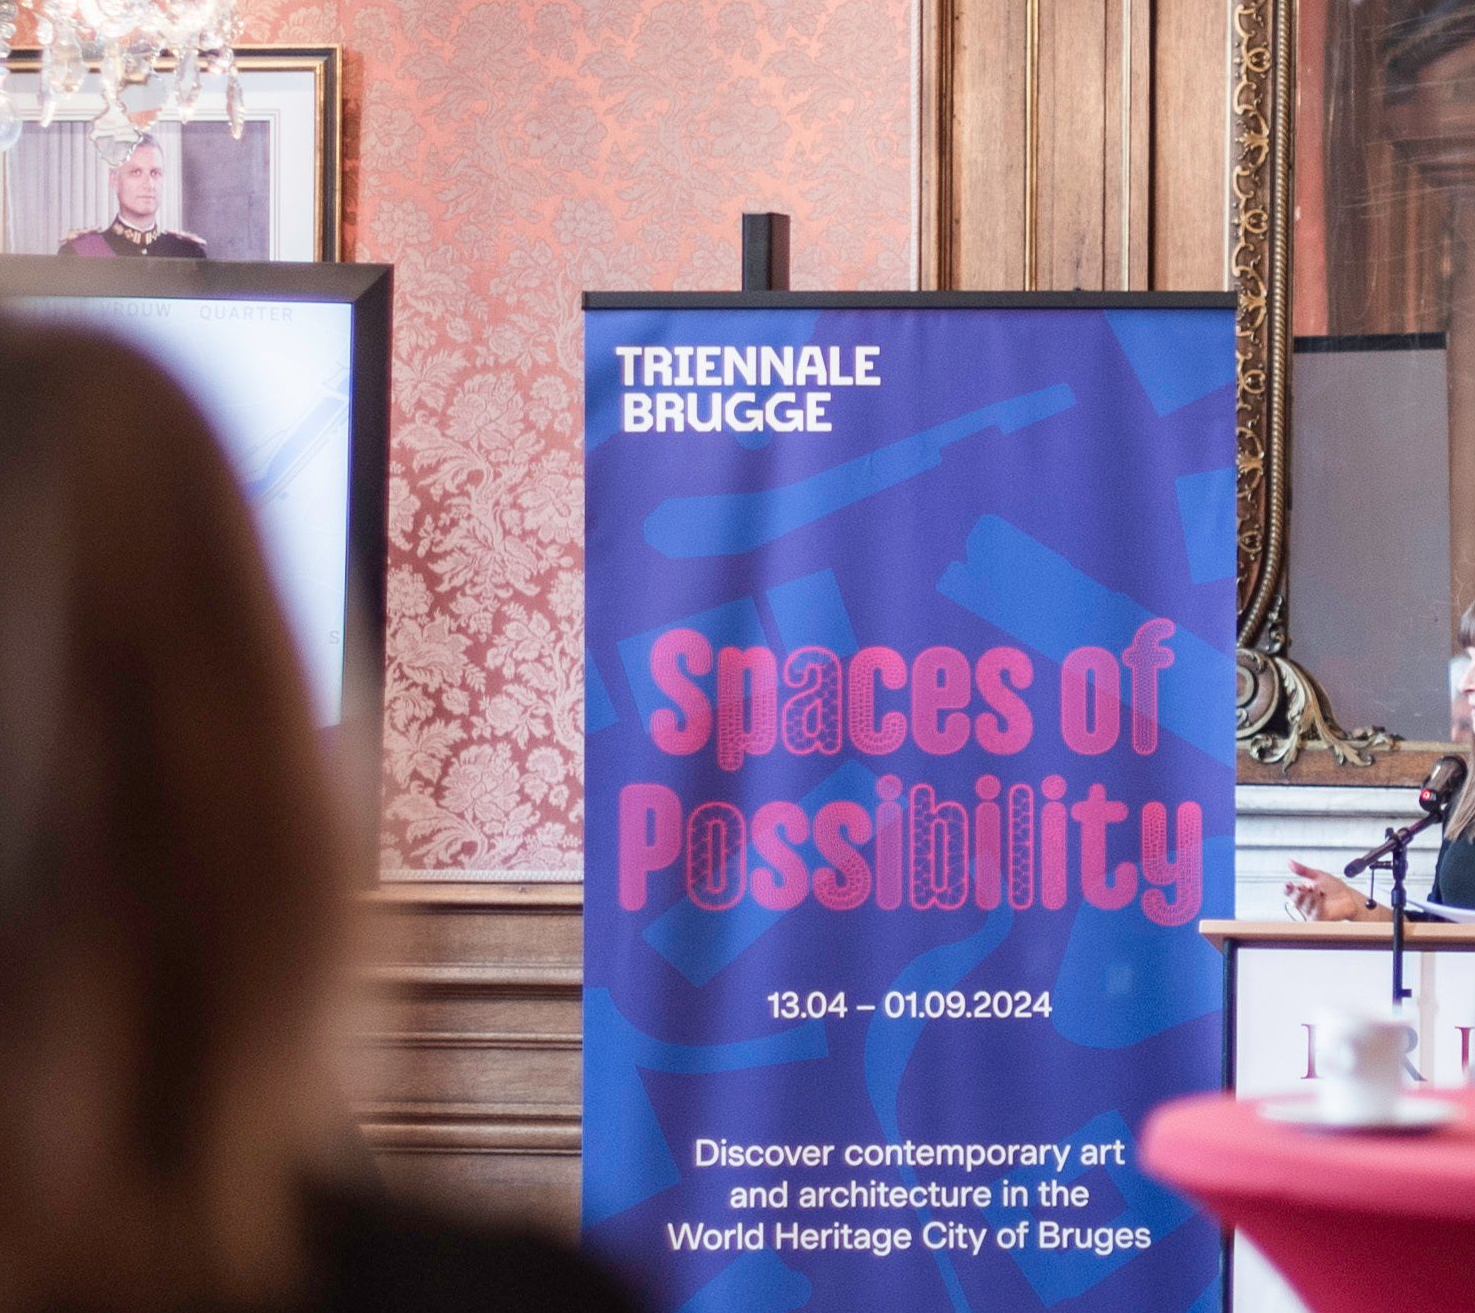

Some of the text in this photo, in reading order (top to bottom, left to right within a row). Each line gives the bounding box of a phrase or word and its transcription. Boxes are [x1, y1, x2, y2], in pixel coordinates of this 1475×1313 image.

[199, 304, 294, 322] QUARTER
[616, 345, 881, 387] TRIENNALE
[624, 392, 833, 433] BRUGGE
[649, 617, 1176, 772] Spaces of
[617, 774, 1203, 927] Possibility
[767, 991, 848, 1019] 13.04
[884, 990, 1053, 1019] 01.09.2024
[695, 1138, 1126, 1173] Discover contemporary art
[729, 1179, 1090, 1208] and architecture in the
[667, 1220, 1152, 1257] World Heritage City of Bruges
